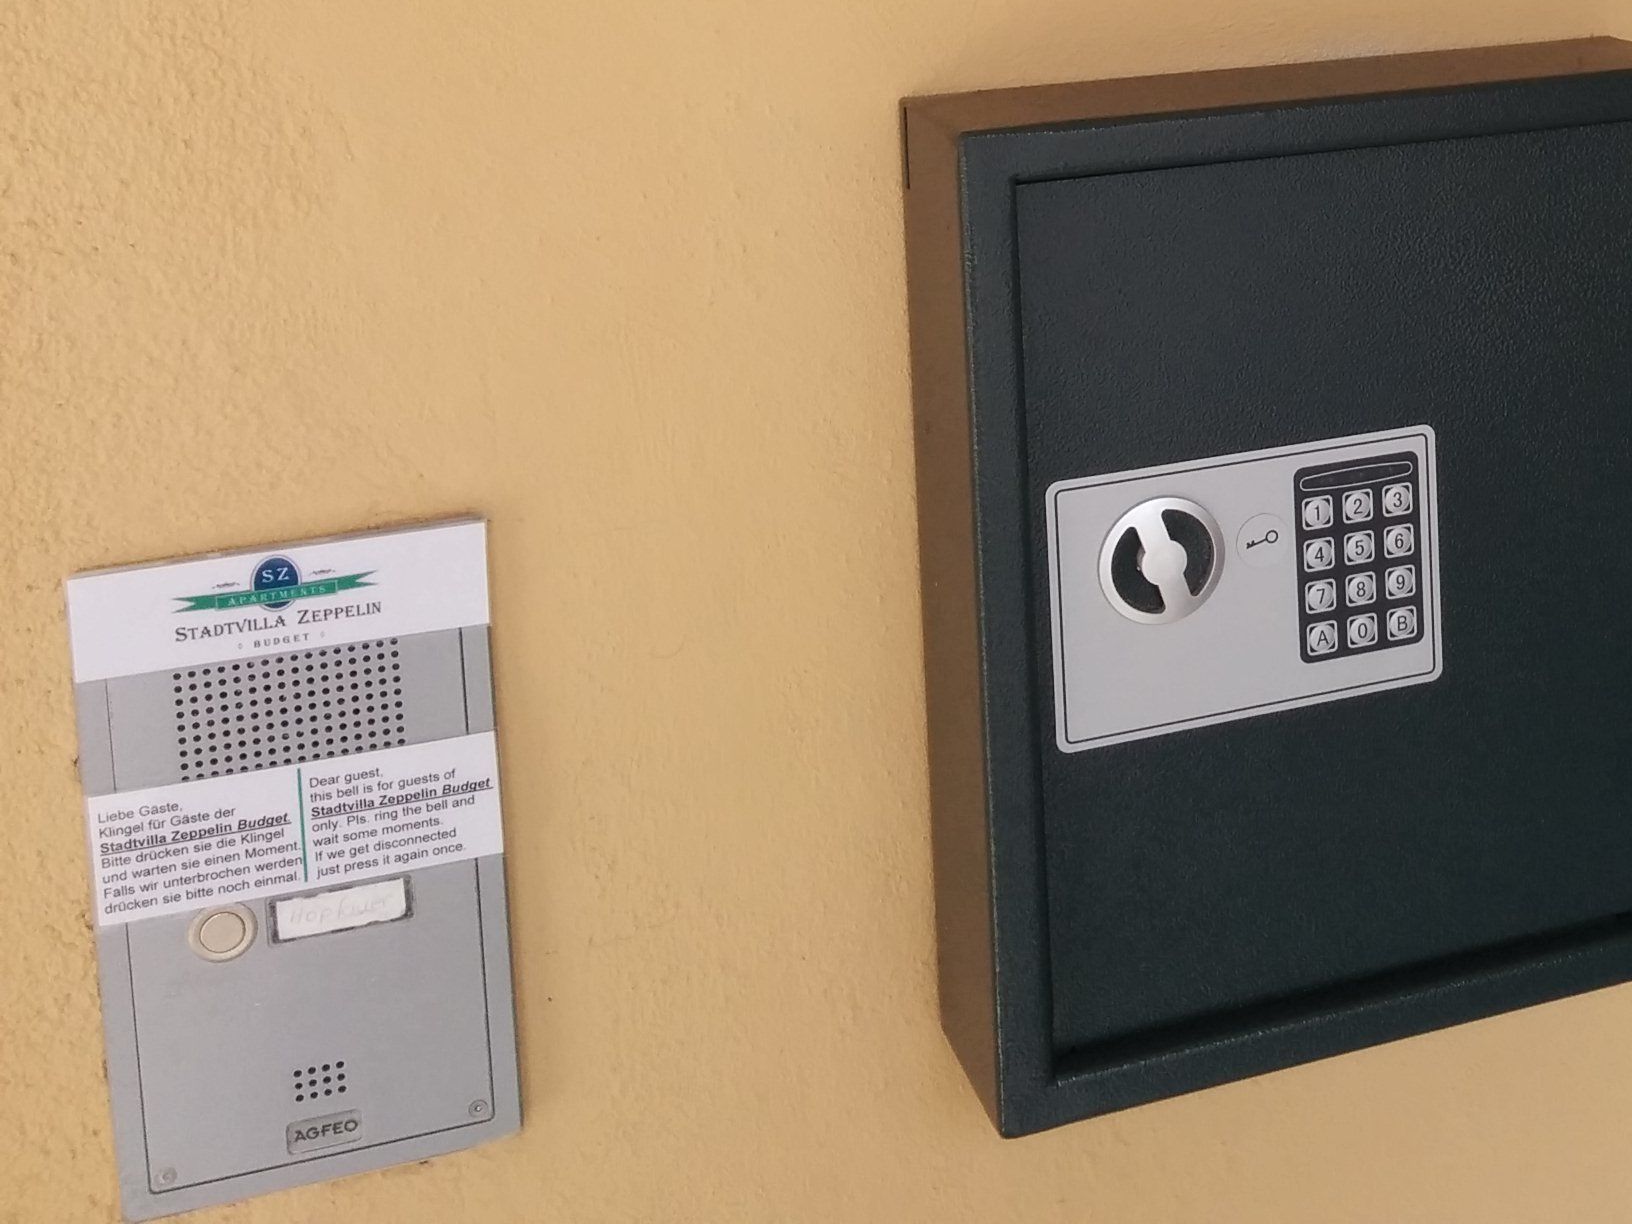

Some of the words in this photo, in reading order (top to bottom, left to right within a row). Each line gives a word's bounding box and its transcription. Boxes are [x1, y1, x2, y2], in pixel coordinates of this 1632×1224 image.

[1314, 504, 1321, 521] 1
[1353, 498, 1363, 515] 2
[1392, 492, 1403, 508] 3
[1314, 546, 1325, 563] 4
[1355, 540, 1365, 556] 5
[1394, 533, 1404, 549] 6
[261, 567, 289, 583] SZ
[1316, 588, 1326, 605] 7
[1356, 581, 1366, 598] 8
[1396, 574, 1405, 590] 9
[227, 584, 327, 606] APARTMENTS
[174, 615, 286, 642] STADTVILLA
[297, 601, 382, 625] ZEPPELIN
[1317, 630, 1329, 647] A
[1397, 615, 1408, 631] B
[253, 632, 310, 648] BUDGET
[309, 774, 342, 788] Dear
[310, 787, 334, 803] this
[335, 781, 361, 798] bell
[362, 780, 375, 794] is
[376, 778, 395, 792] for
[396, 771, 441, 792] guests
[442, 766, 456, 782] of
[312, 795, 376, 818] Stadtvilla
[377, 785, 438, 807] Zeppelin
[440, 777, 491, 797] Budget
[373, 807, 400, 823] ring
[401, 802, 424, 818] the
[425, 797, 450, 814] bell
[451, 793, 476, 810] and
[313, 830, 340, 847] wait
[342, 826, 379, 842] some
[315, 846, 325, 862] If
[325, 847, 347, 859] we
[348, 841, 371, 859] get
[372, 825, 457, 852] disconnected
[317, 860, 342, 879] just
[343, 856, 380, 875] press
[382, 852, 392, 866] it
[393, 846, 430, 866] again
[294, 1119, 358, 1143] AGFEO
